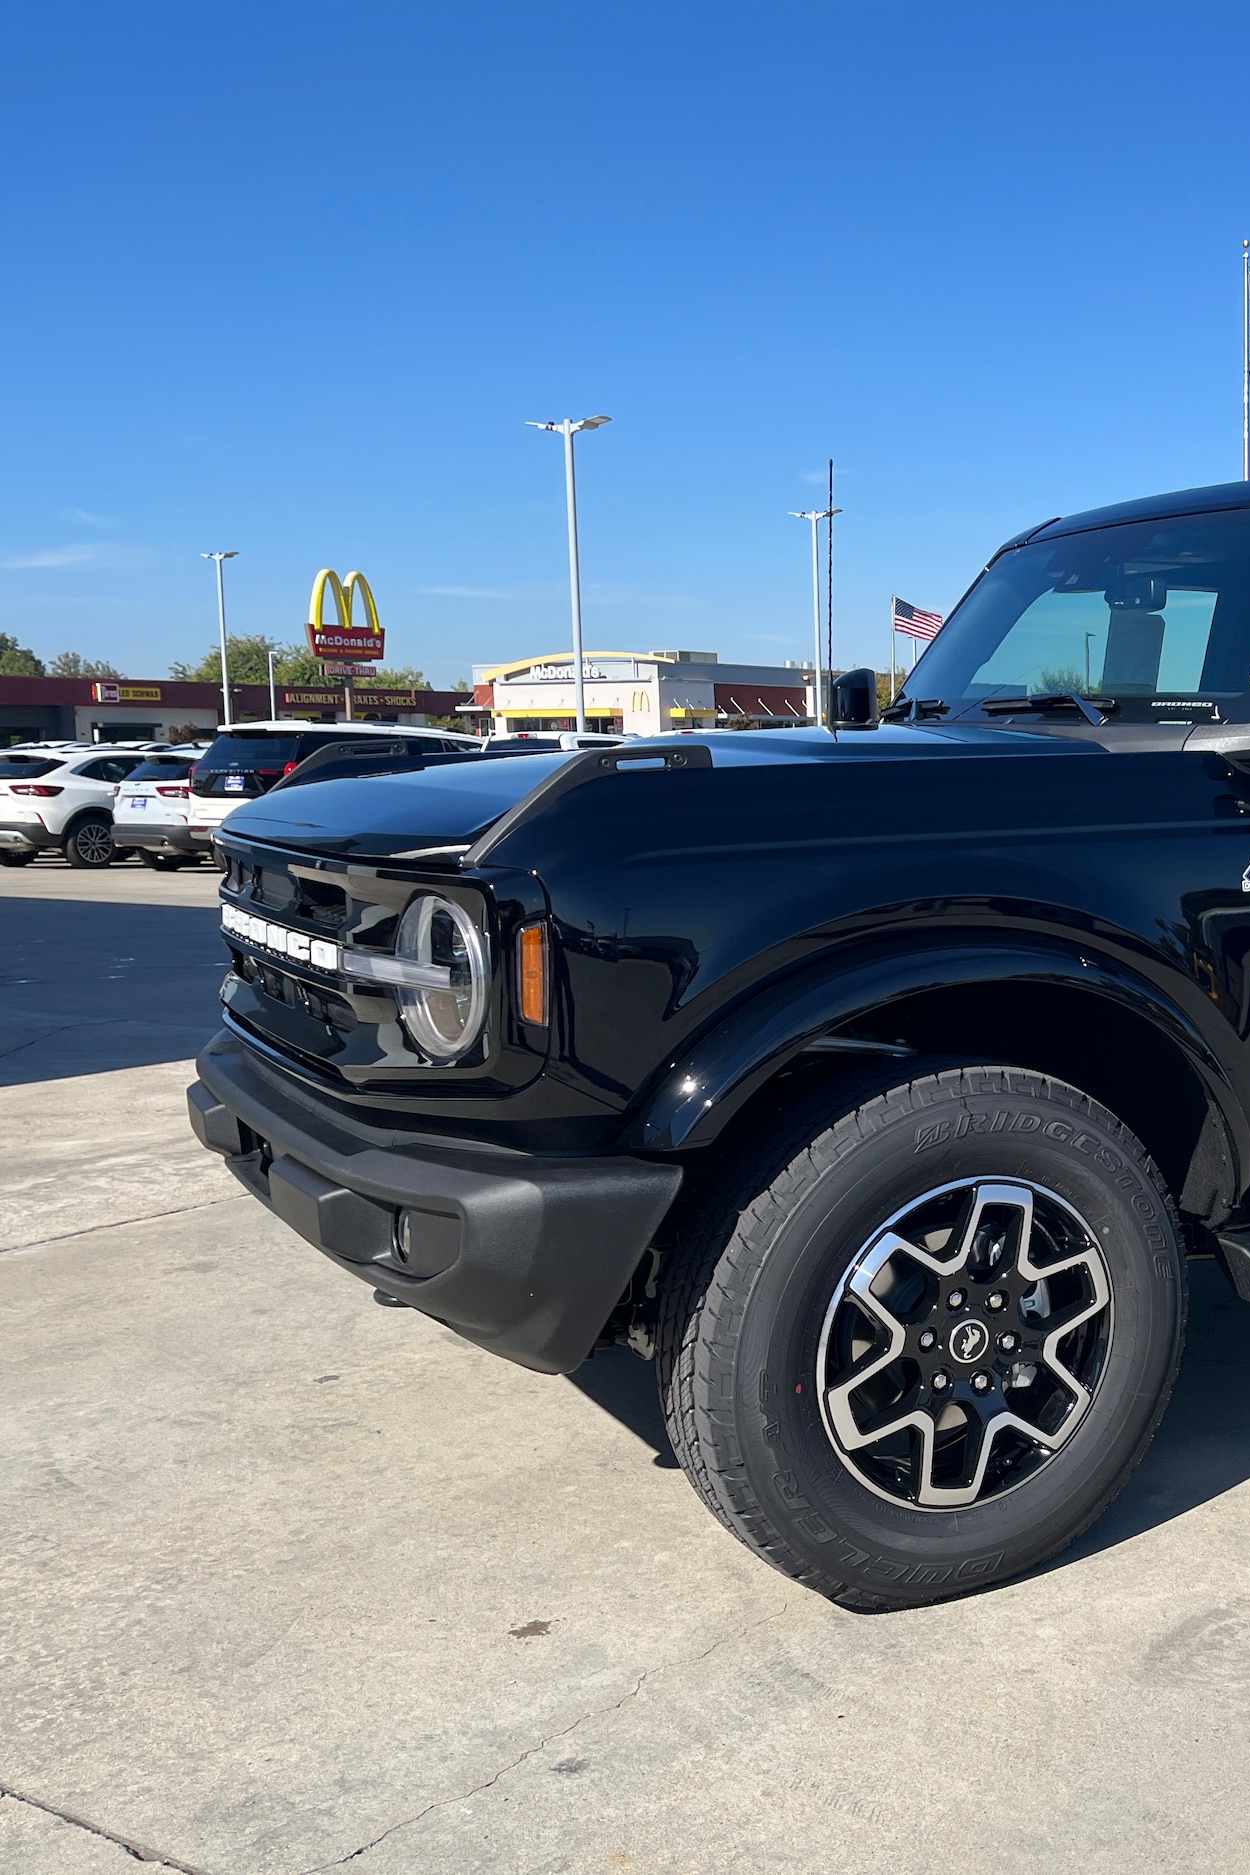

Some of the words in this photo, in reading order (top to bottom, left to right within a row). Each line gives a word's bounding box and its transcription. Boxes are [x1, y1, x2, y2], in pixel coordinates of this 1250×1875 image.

[315, 634, 382, 648] McDonald's
[329, 666, 376, 675] DRIVE-THRU
[530, 664, 600, 679] McDond's
[289, 693, 340, 704] ALIGNMENT
[352, 695, 379, 705] RAKES
[385, 695, 416, 706] SHOCKS
[221, 903, 338, 970] BRONCO
[913, 1110, 1175, 1280] BRIDGESTONE
[770, 1469, 1005, 1585] DUELER
